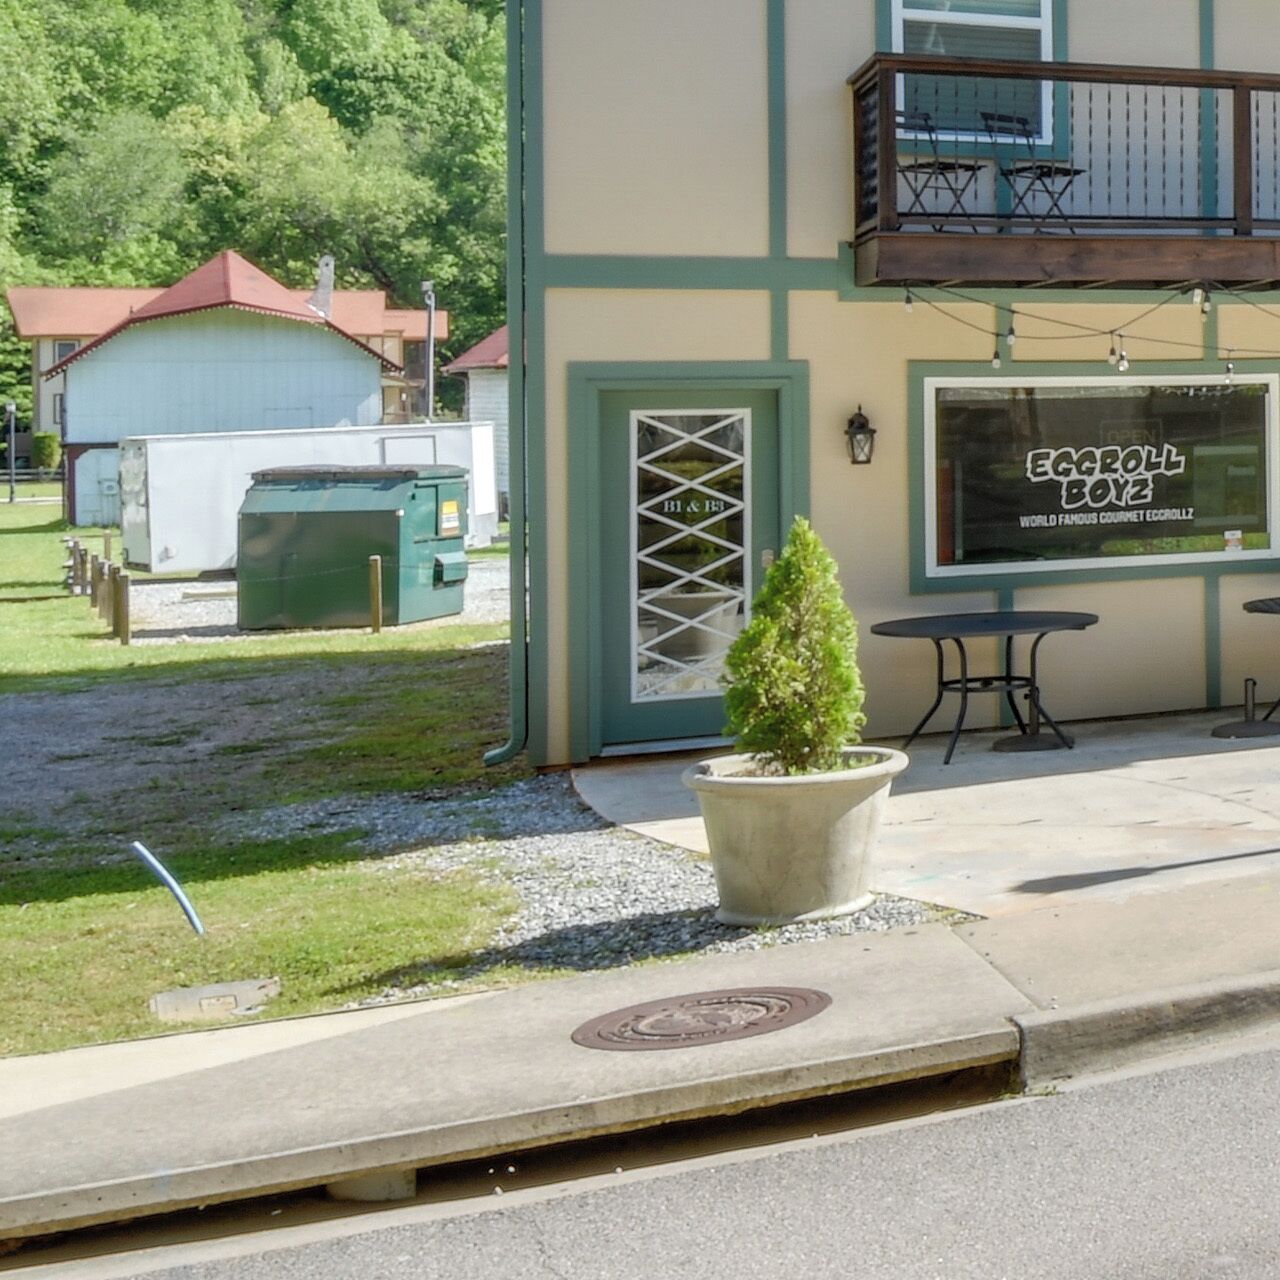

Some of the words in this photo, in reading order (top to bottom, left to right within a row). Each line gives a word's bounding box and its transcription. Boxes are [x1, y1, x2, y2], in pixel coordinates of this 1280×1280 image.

[1026, 443, 1186, 483] EGGROLL
[1061, 475, 1154, 509] BOYZ
[663, 500, 681, 513] B1
[686, 500, 700, 513] &
[704, 500, 725, 513] B3
[1019, 514, 1057, 528] WORLD
[1058, 512, 1098, 526] FAMOUS
[1099, 510, 1145, 524] GOURMET
[1146, 508, 1194, 522] EGGROLLZ
